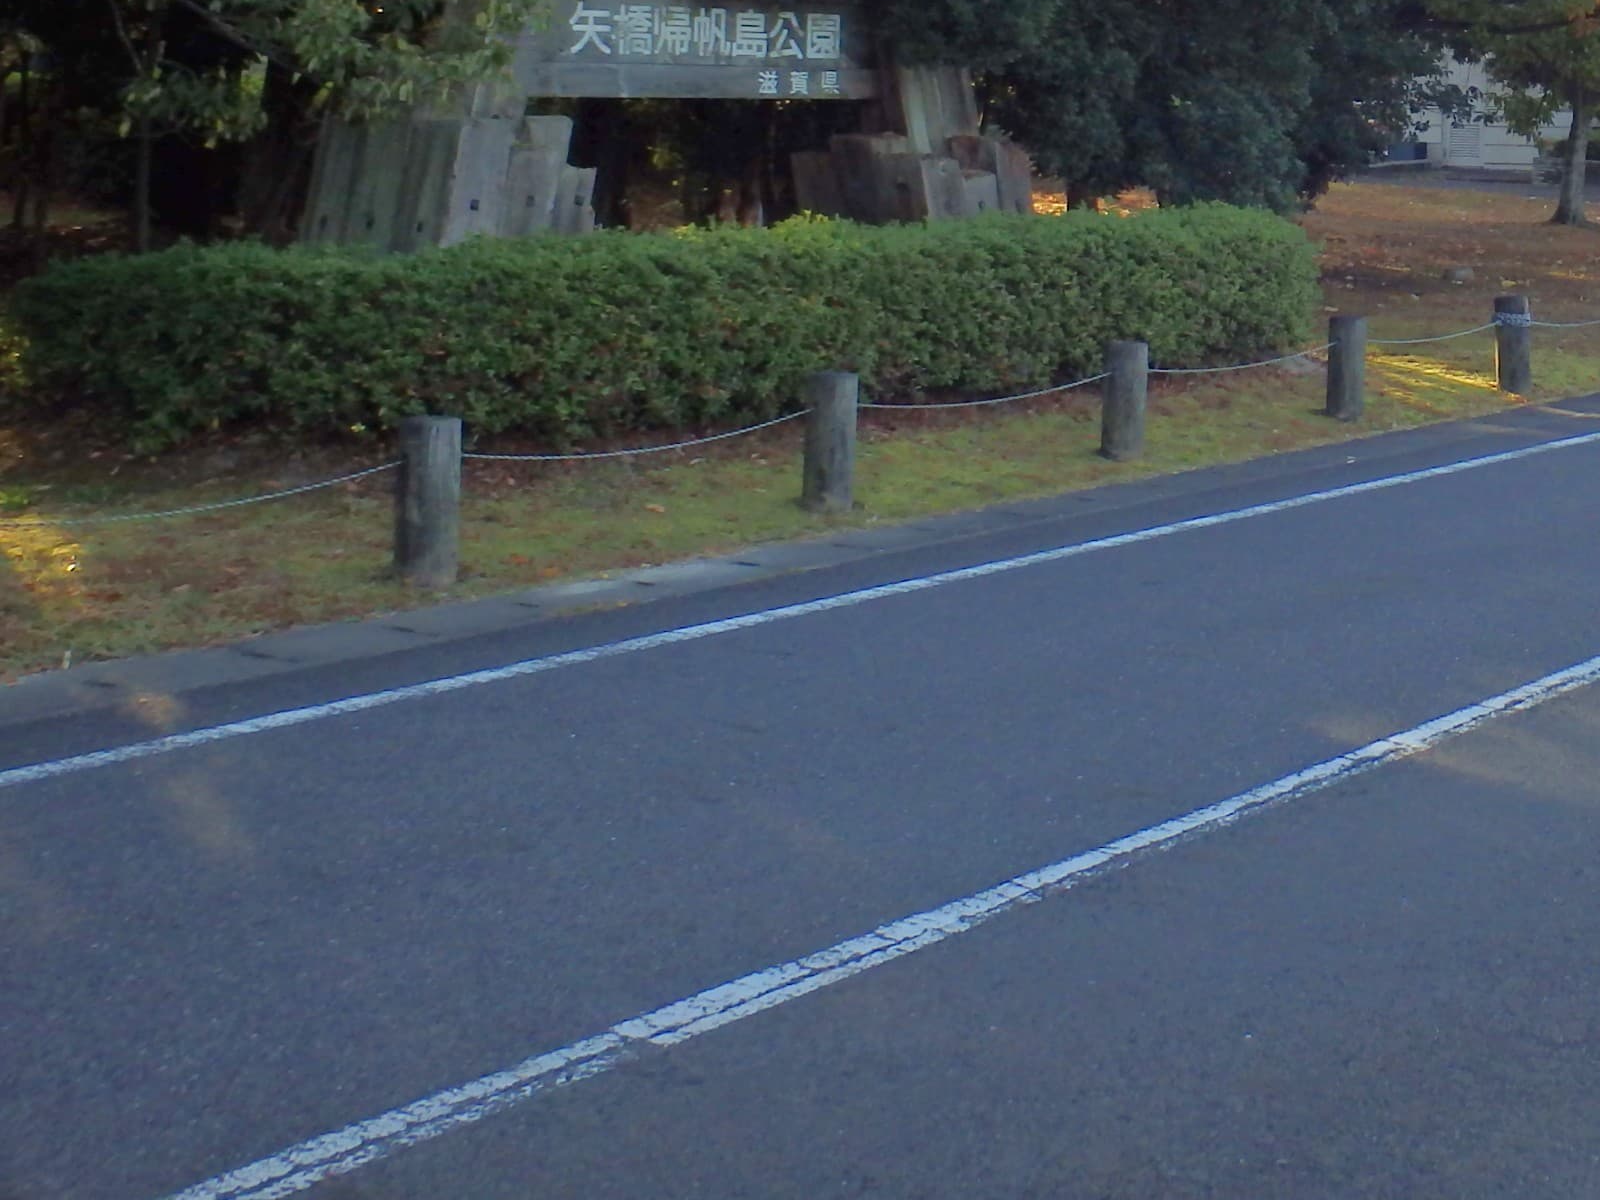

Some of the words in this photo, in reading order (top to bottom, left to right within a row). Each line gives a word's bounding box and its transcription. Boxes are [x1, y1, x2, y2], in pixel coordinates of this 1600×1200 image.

[569, 1, 841, 60] 矢橋帰帆島公園
[757, 70, 841, 95] 滋賀県
